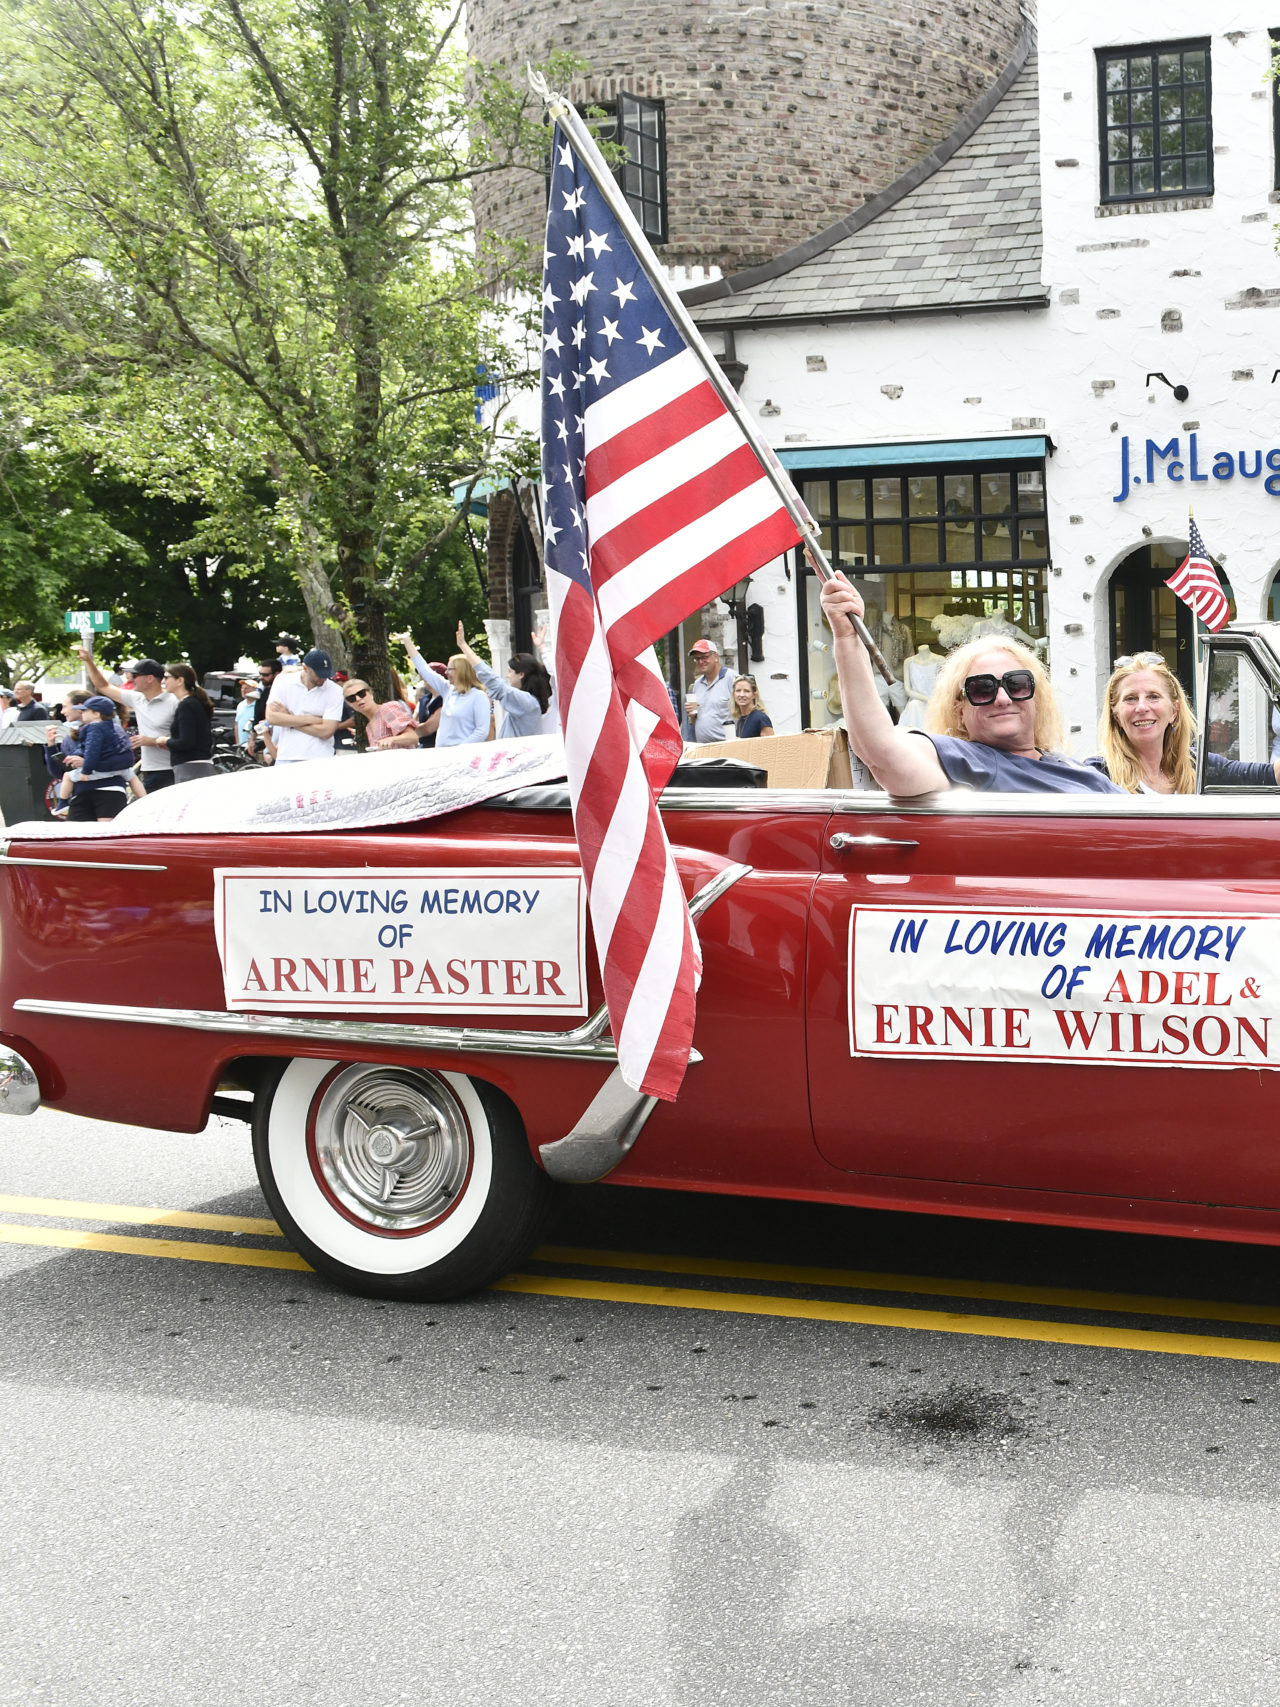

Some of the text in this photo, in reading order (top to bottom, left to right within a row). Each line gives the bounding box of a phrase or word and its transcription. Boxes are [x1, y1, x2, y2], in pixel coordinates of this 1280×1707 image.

[69, 611, 90, 630] JOBS
[1179, 638, 1186, 650] 2
[259, 889, 540, 914] IN LOVING MEMORY
[378, 924, 413, 949] OF
[889, 918, 1246, 962] IN LOVING MEMORY
[242, 957, 567, 996] ARNIE PASTER
[1041, 964, 1262, 1006] OF ADEL &
[872, 1003, 1273, 1058] ERNIE WILSON
